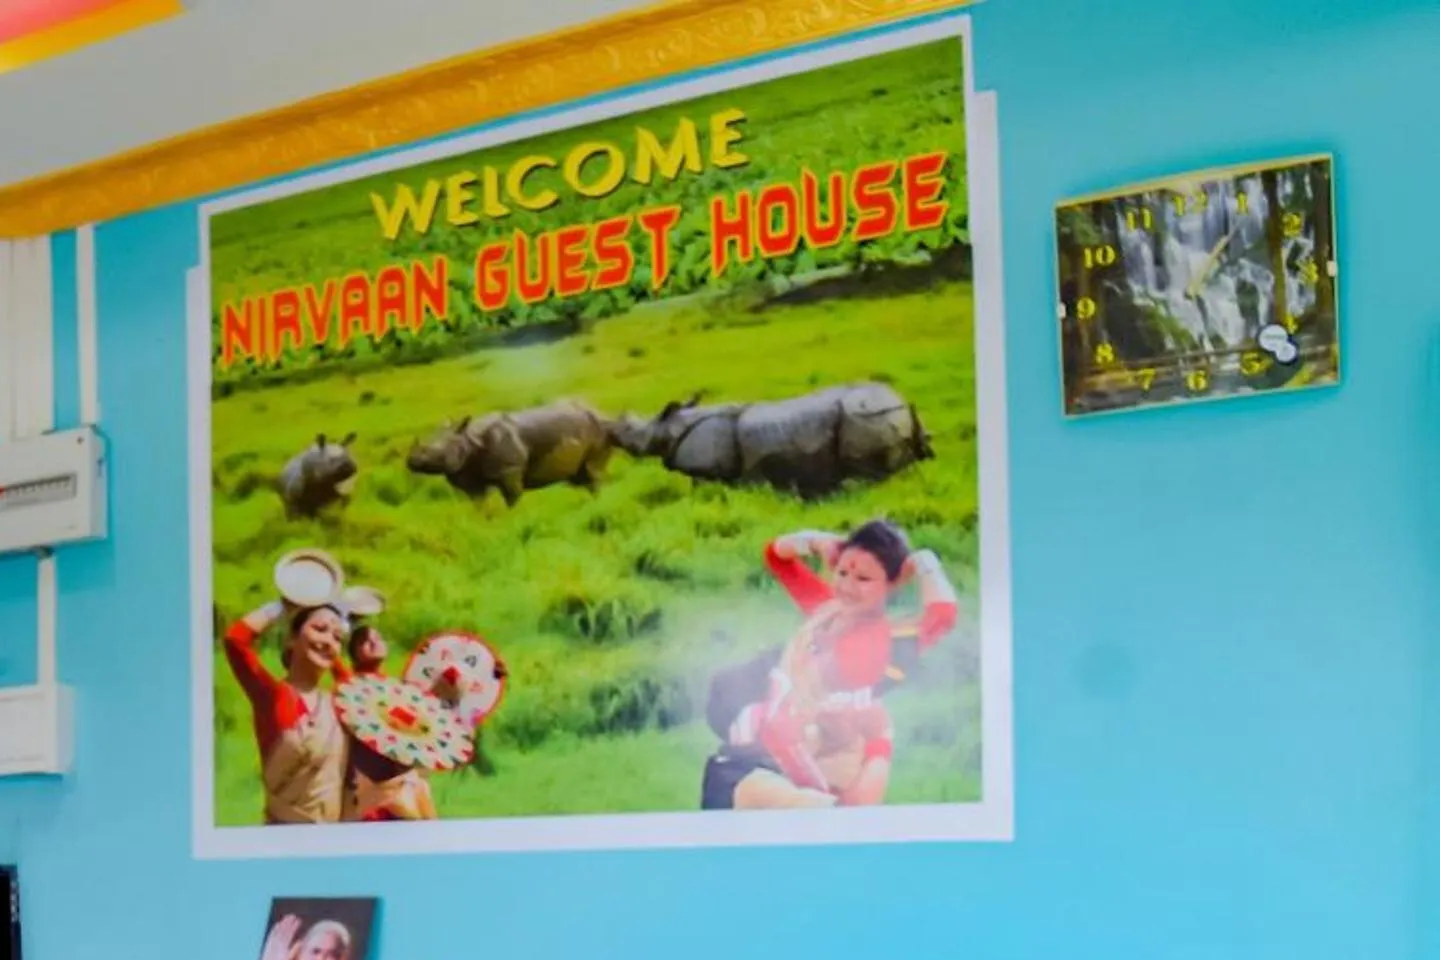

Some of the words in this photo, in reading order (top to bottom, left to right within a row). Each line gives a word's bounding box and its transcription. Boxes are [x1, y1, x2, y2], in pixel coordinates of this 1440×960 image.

[369, 106, 750, 241] WELCOME
[1126, 208, 1153, 232] 11
[221, 256, 448, 367] NIRVAAN
[476, 206, 681, 310] GUEST
[710, 152, 949, 275] HOUSE
[1084, 245, 1116, 269] 10
[1077, 296, 1096, 320] 9
[1138, 367, 1156, 391] 7
[1187, 370, 1206, 391] 6
